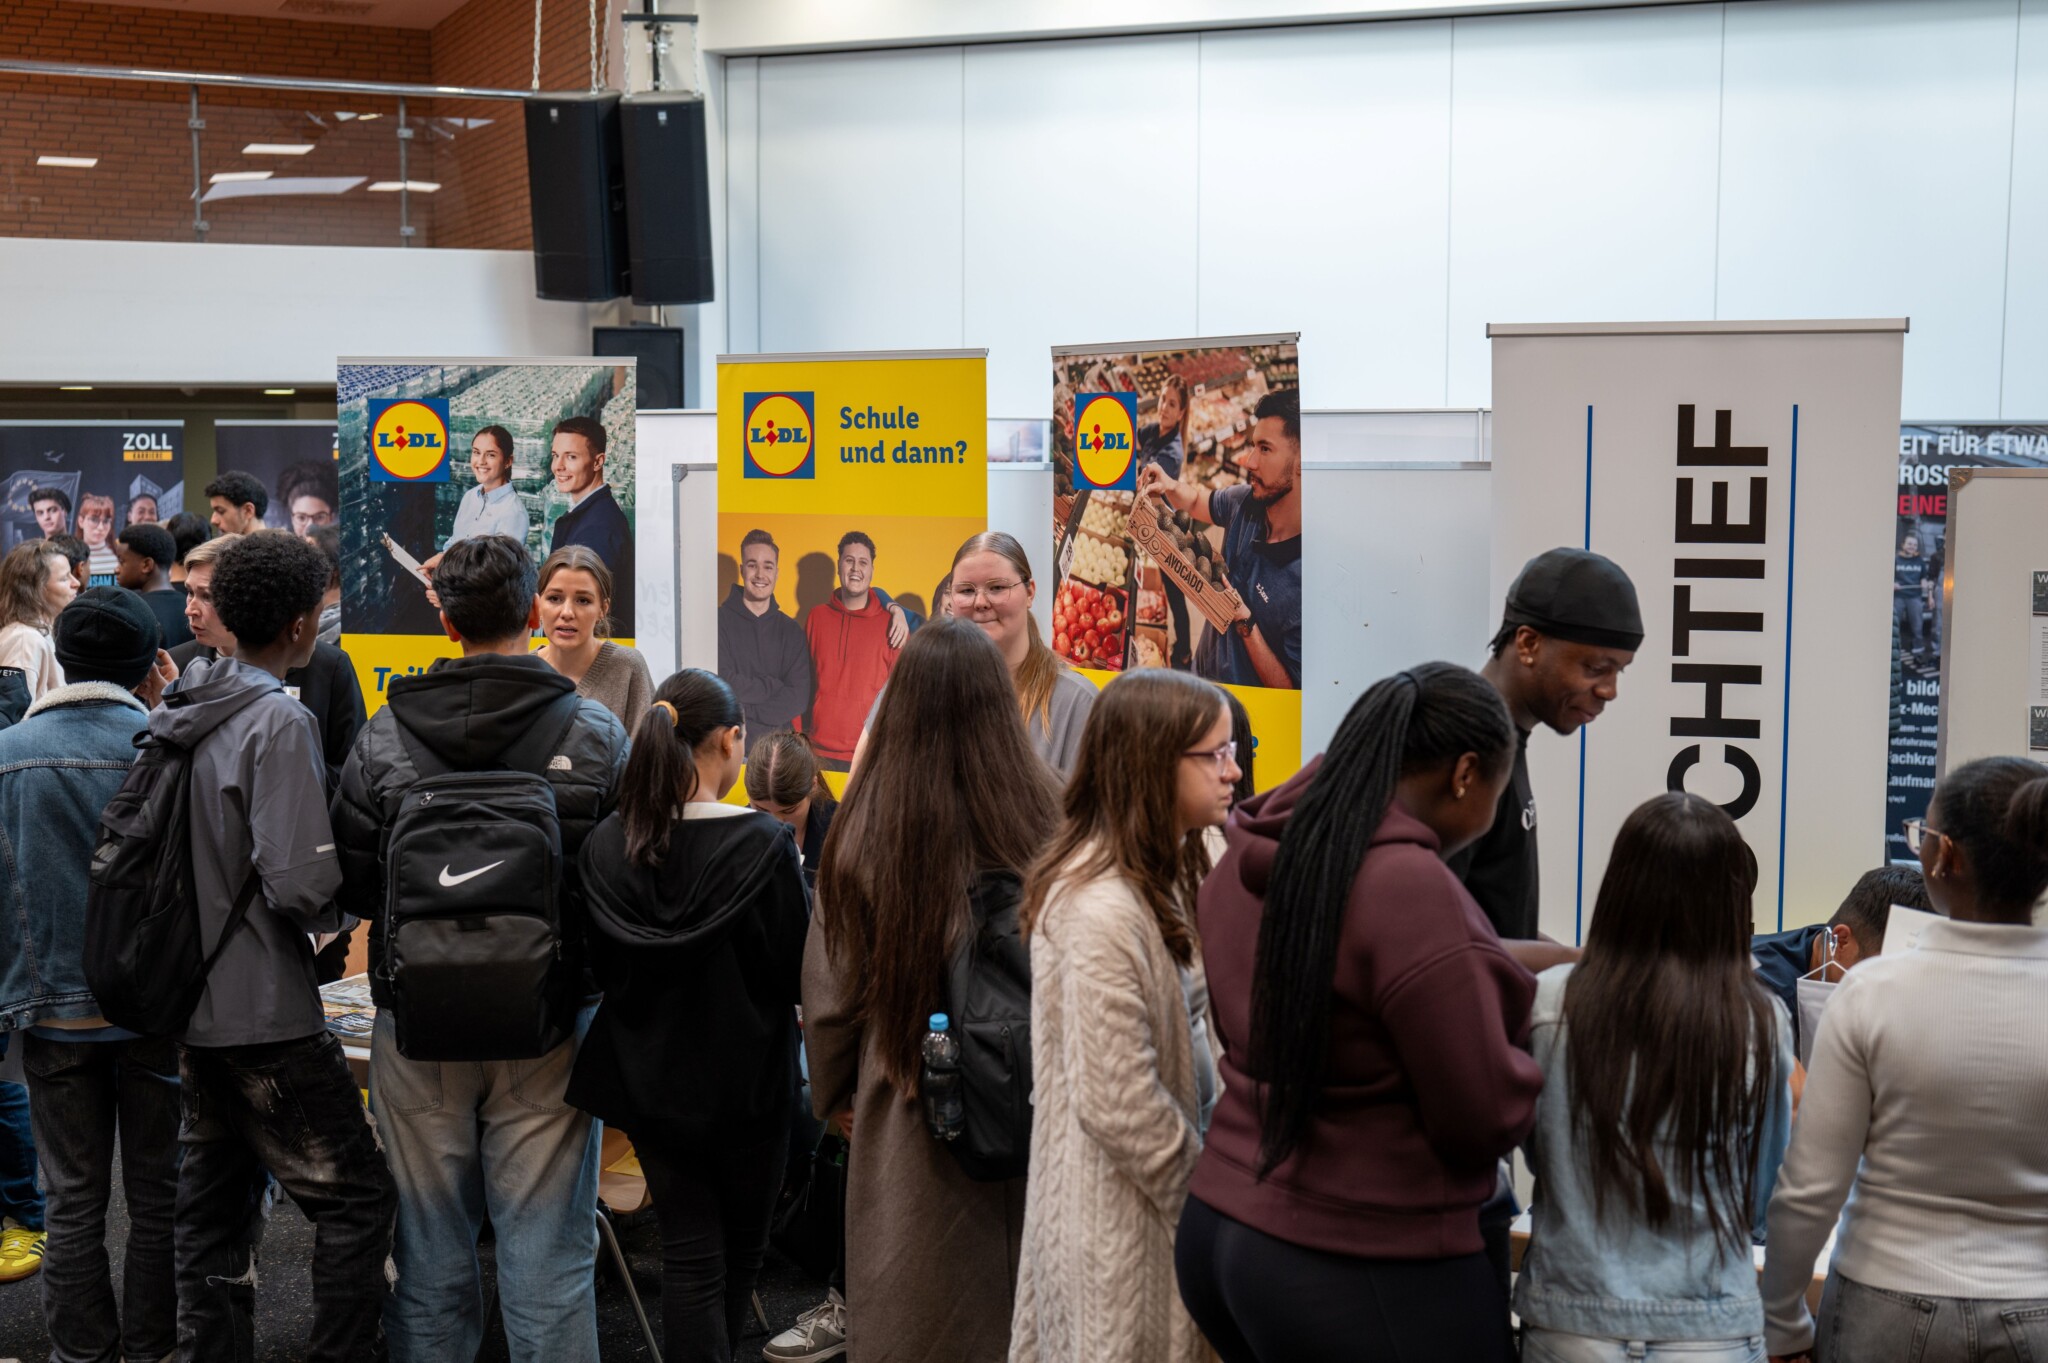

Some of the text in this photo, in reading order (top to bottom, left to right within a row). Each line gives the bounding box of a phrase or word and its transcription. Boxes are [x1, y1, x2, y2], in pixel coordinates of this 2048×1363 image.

[840, 405, 920, 430] Schule
[122, 433, 173, 451] ZOLL
[840, 440, 968, 464] und dann?
[1938, 429, 1981, 456] FÜR
[1164, 552, 1204, 594] AVOCADO
[1666, 404, 1769, 825] CHTIEF
[1889, 751, 1937, 767] achkra
